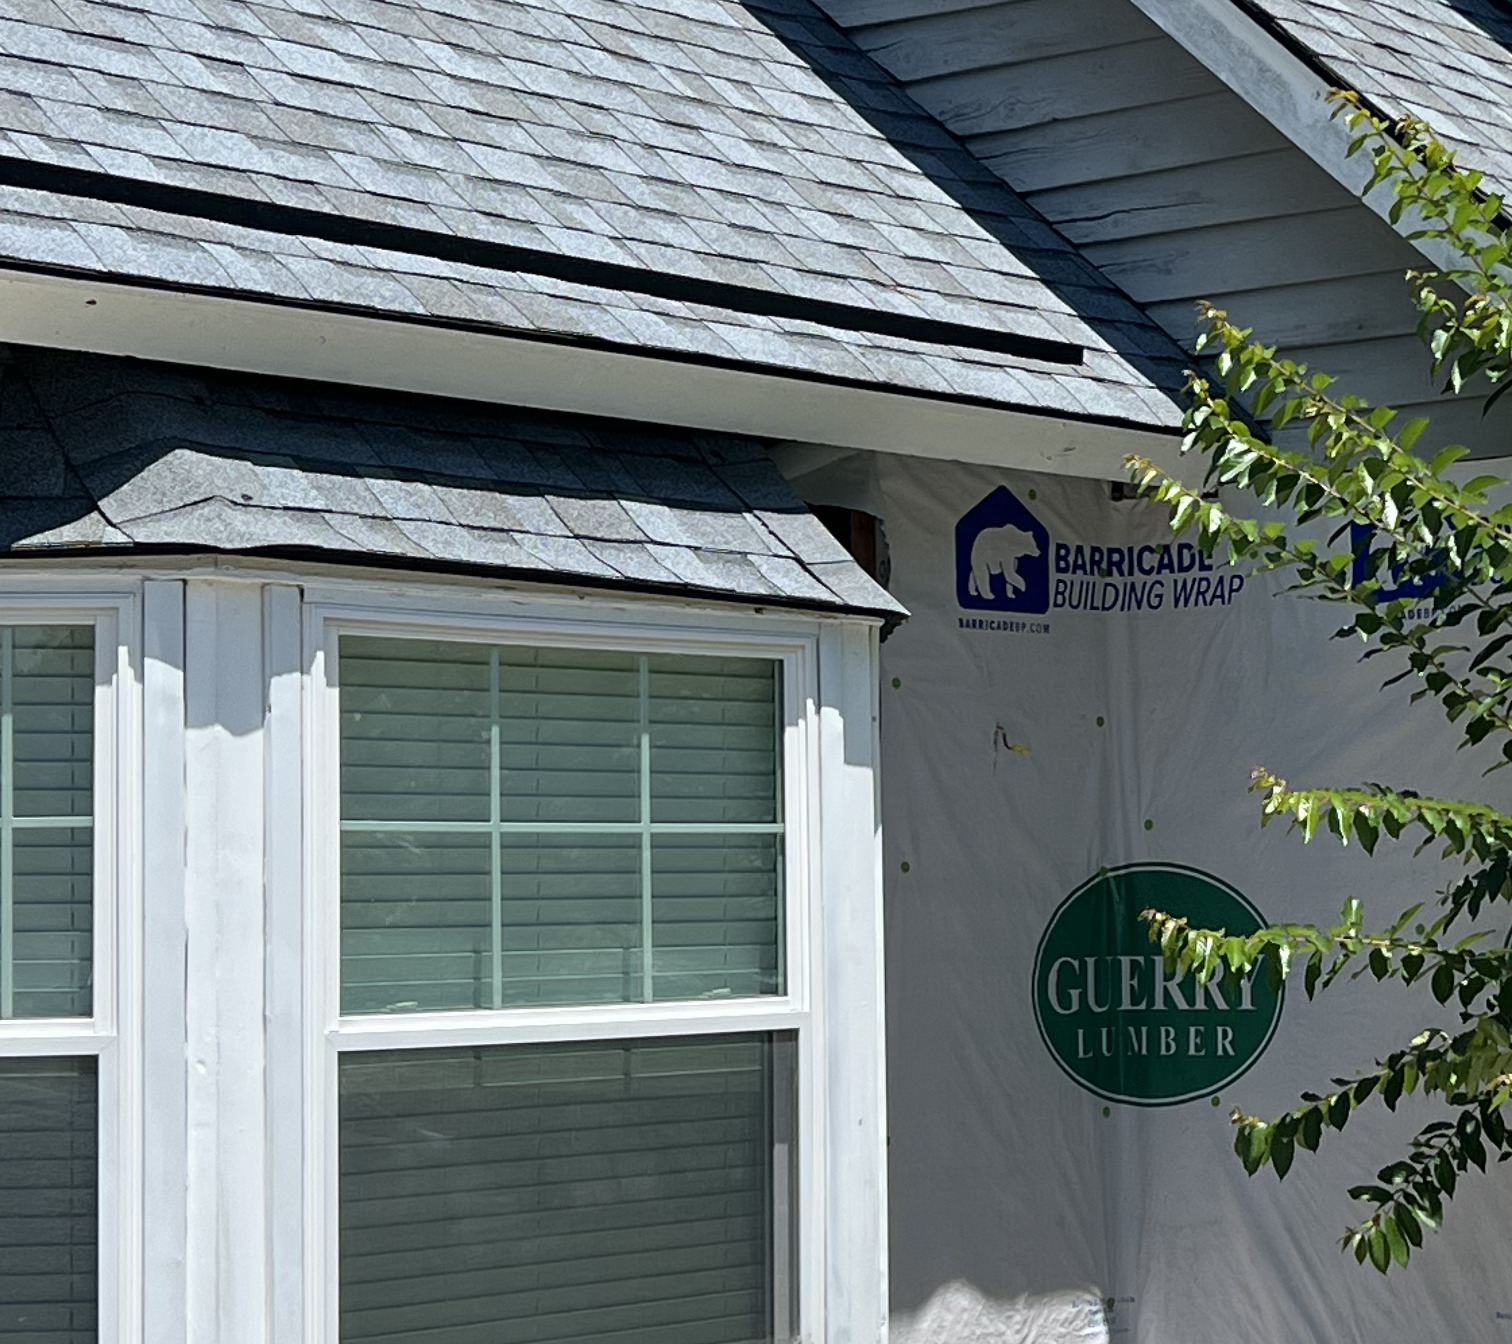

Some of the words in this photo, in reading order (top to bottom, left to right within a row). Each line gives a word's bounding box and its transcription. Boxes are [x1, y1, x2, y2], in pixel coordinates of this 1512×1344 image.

[1052, 578, 1165, 612] BUILDING
[1173, 574, 1245, 609] WRAP
[1047, 954, 1265, 1015] GUERRY
[1077, 1026, 1236, 1058] LUMBER
